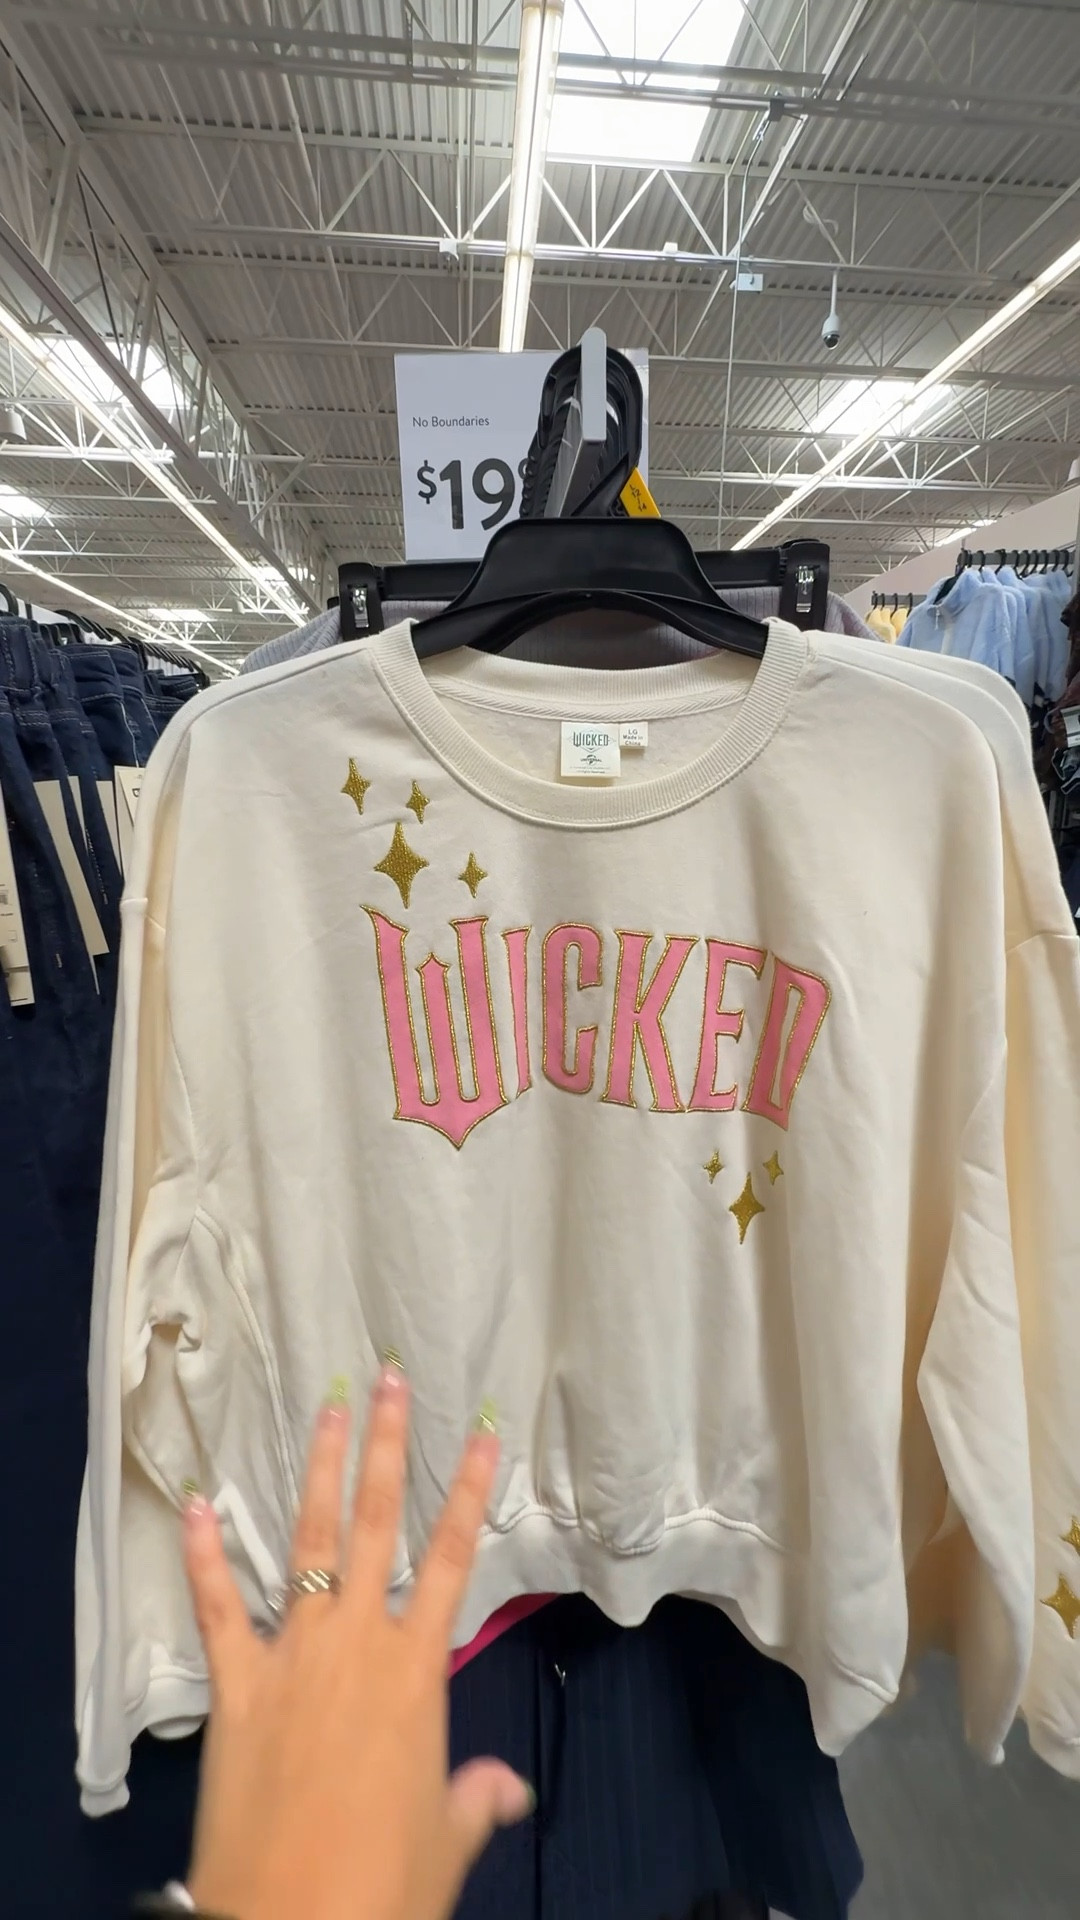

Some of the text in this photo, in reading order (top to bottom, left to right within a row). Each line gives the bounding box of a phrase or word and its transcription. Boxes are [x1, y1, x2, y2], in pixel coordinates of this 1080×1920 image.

[412, 415, 490, 427] No Boundaries
[573, 731, 609, 747] WICKED
[360, 905, 832, 1150] WICKED
